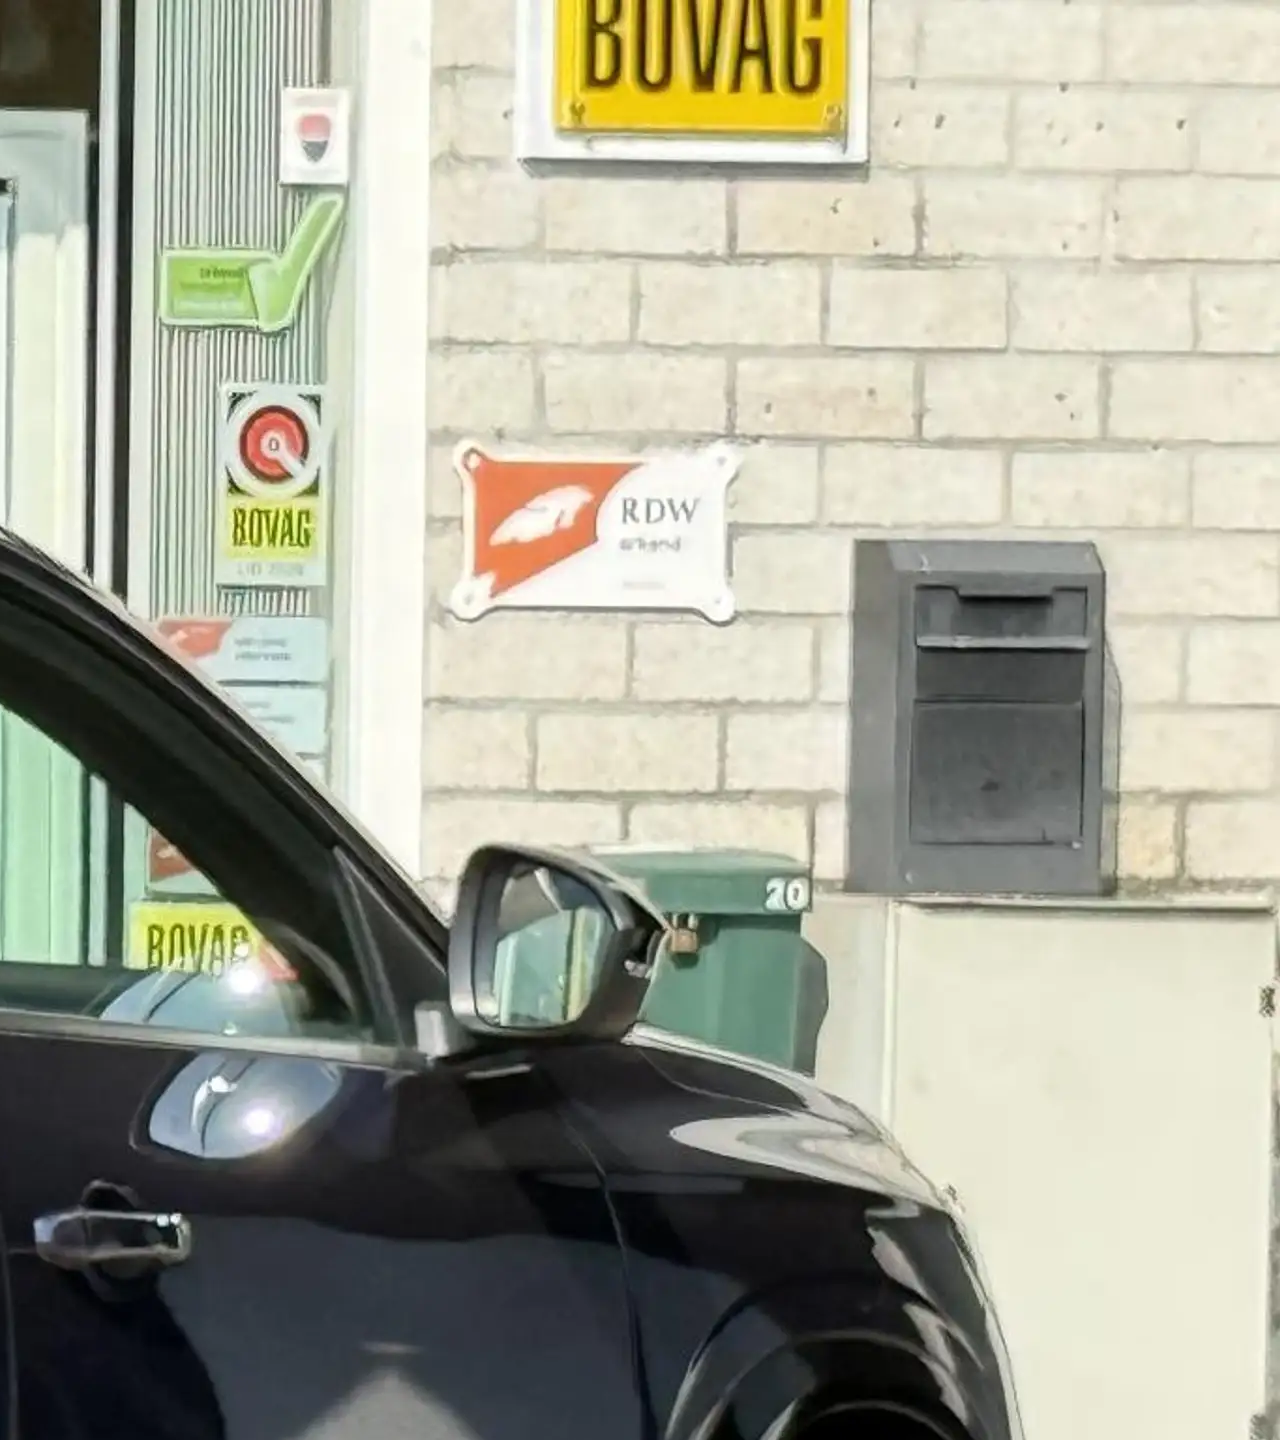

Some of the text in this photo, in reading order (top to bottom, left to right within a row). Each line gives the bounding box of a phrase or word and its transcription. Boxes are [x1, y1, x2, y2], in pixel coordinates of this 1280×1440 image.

[584, 0, 822, 95] BOVAG
[232, 507, 312, 548] BOVAG
[621, 497, 701, 524] RDW
[765, 876, 809, 911] 20
